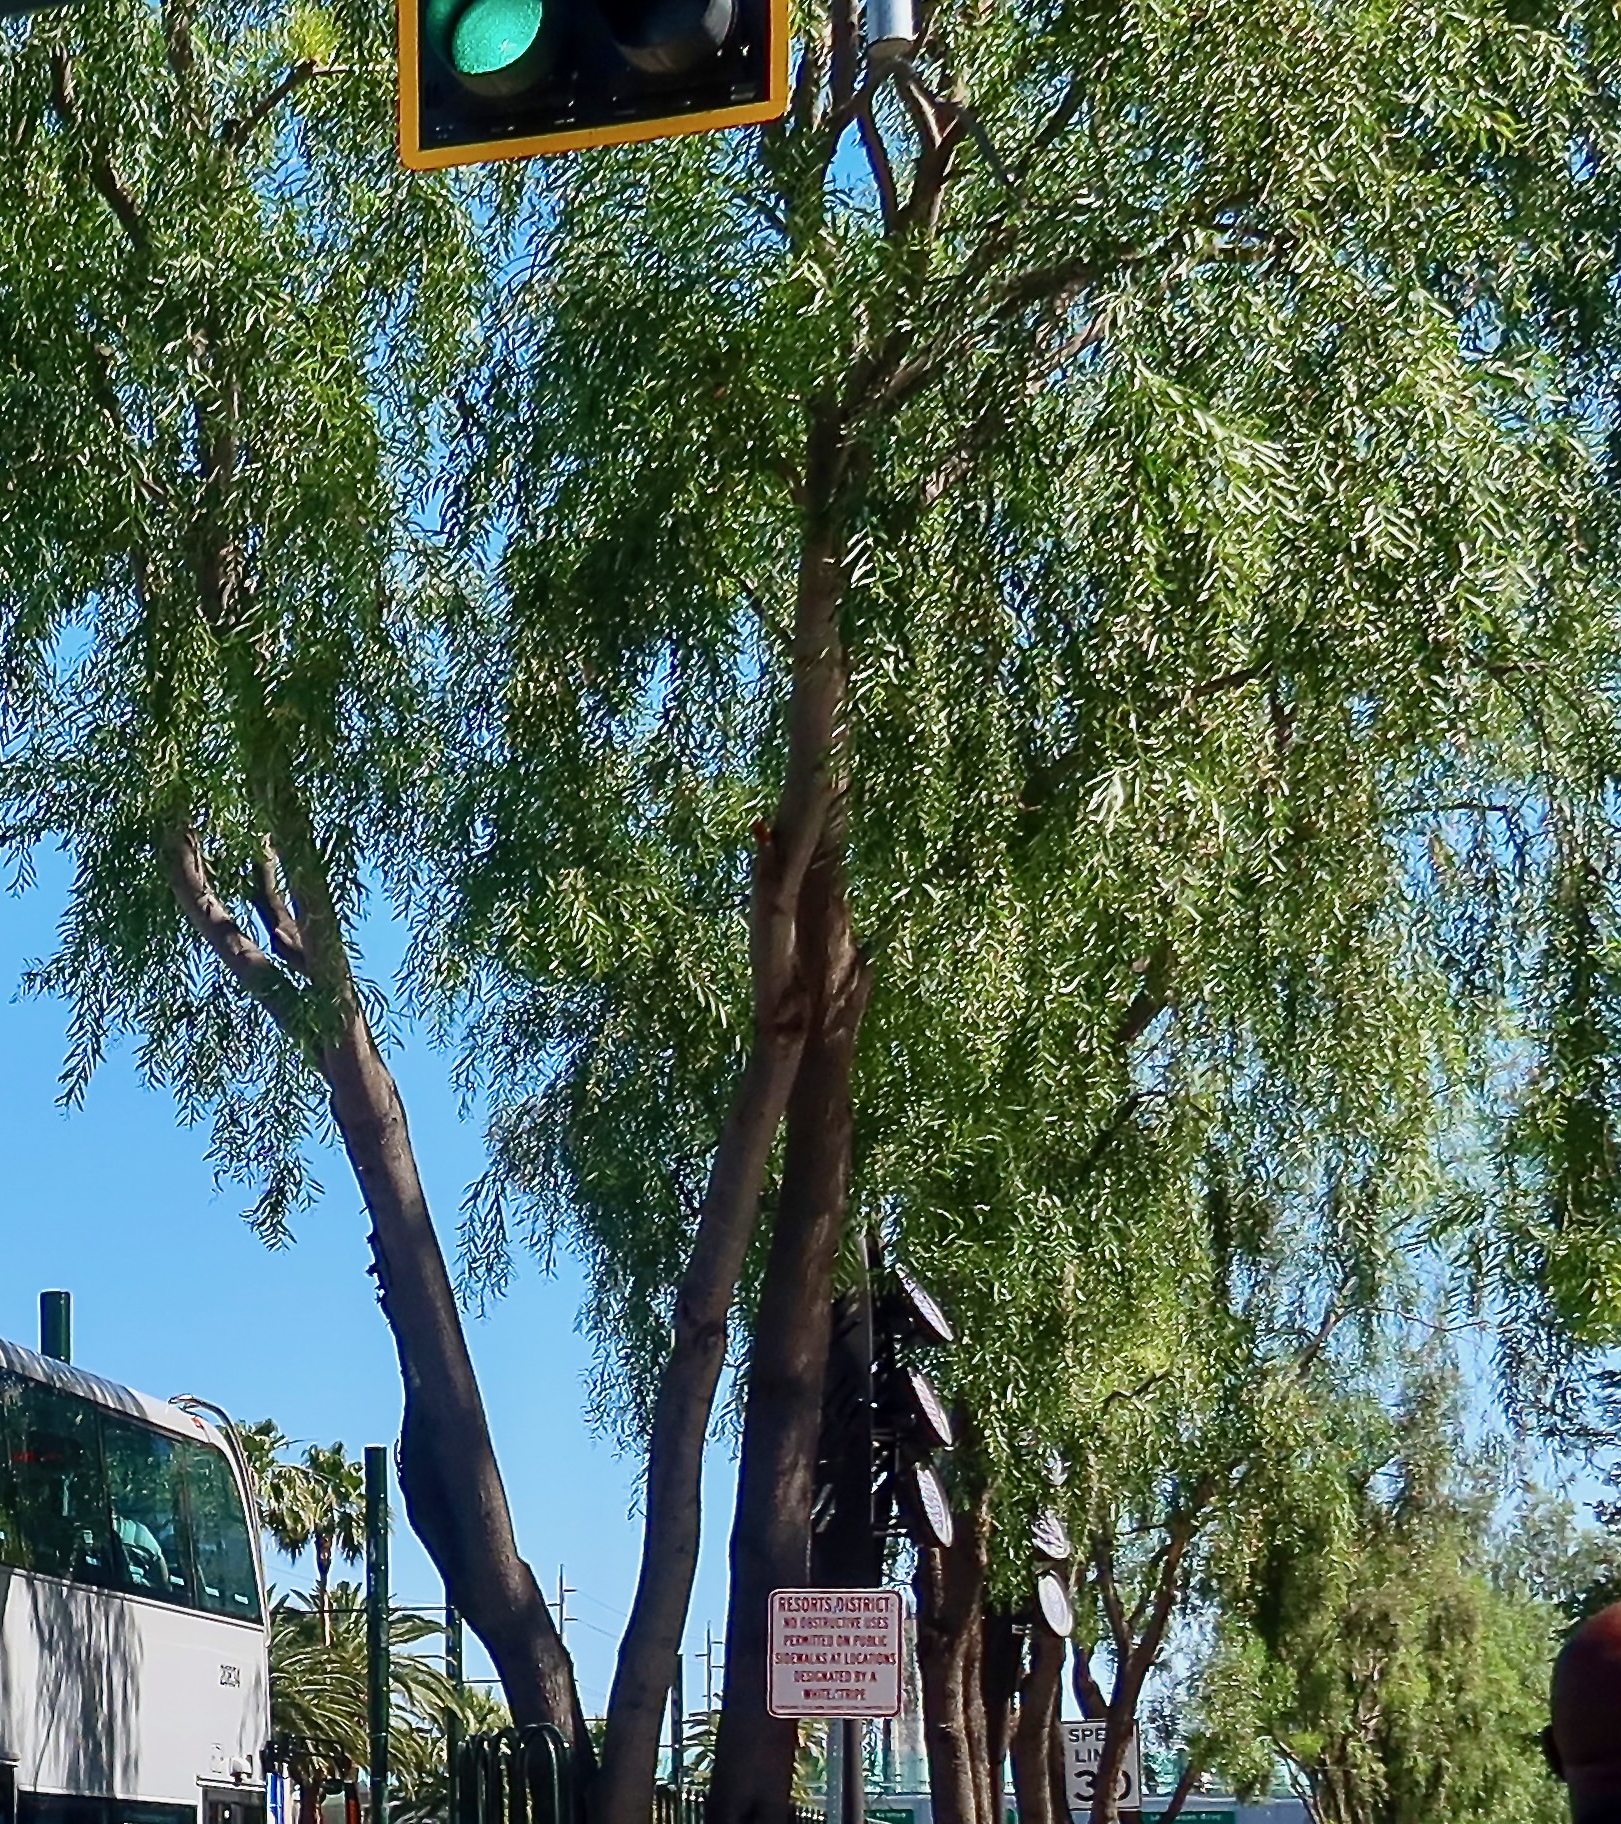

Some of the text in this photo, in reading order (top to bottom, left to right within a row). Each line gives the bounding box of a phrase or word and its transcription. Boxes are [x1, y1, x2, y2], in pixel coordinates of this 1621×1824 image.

[778, 1596, 832, 1612] RESORTS
[783, 1617, 889, 1629] NO OBSTRUCTIVE USES
[783, 1634, 887, 1647] PERMITTED ON PUBLIC
[774, 1652, 897, 1665] SIDEWALKS AT LOCATIONS
[793, 1670, 877, 1683] DESIGNATED BY A
[1069, 1728, 1106, 1743] SPE
[1075, 1749, 1103, 1763] LIM
[1074, 1769, 1132, 1802] 30
